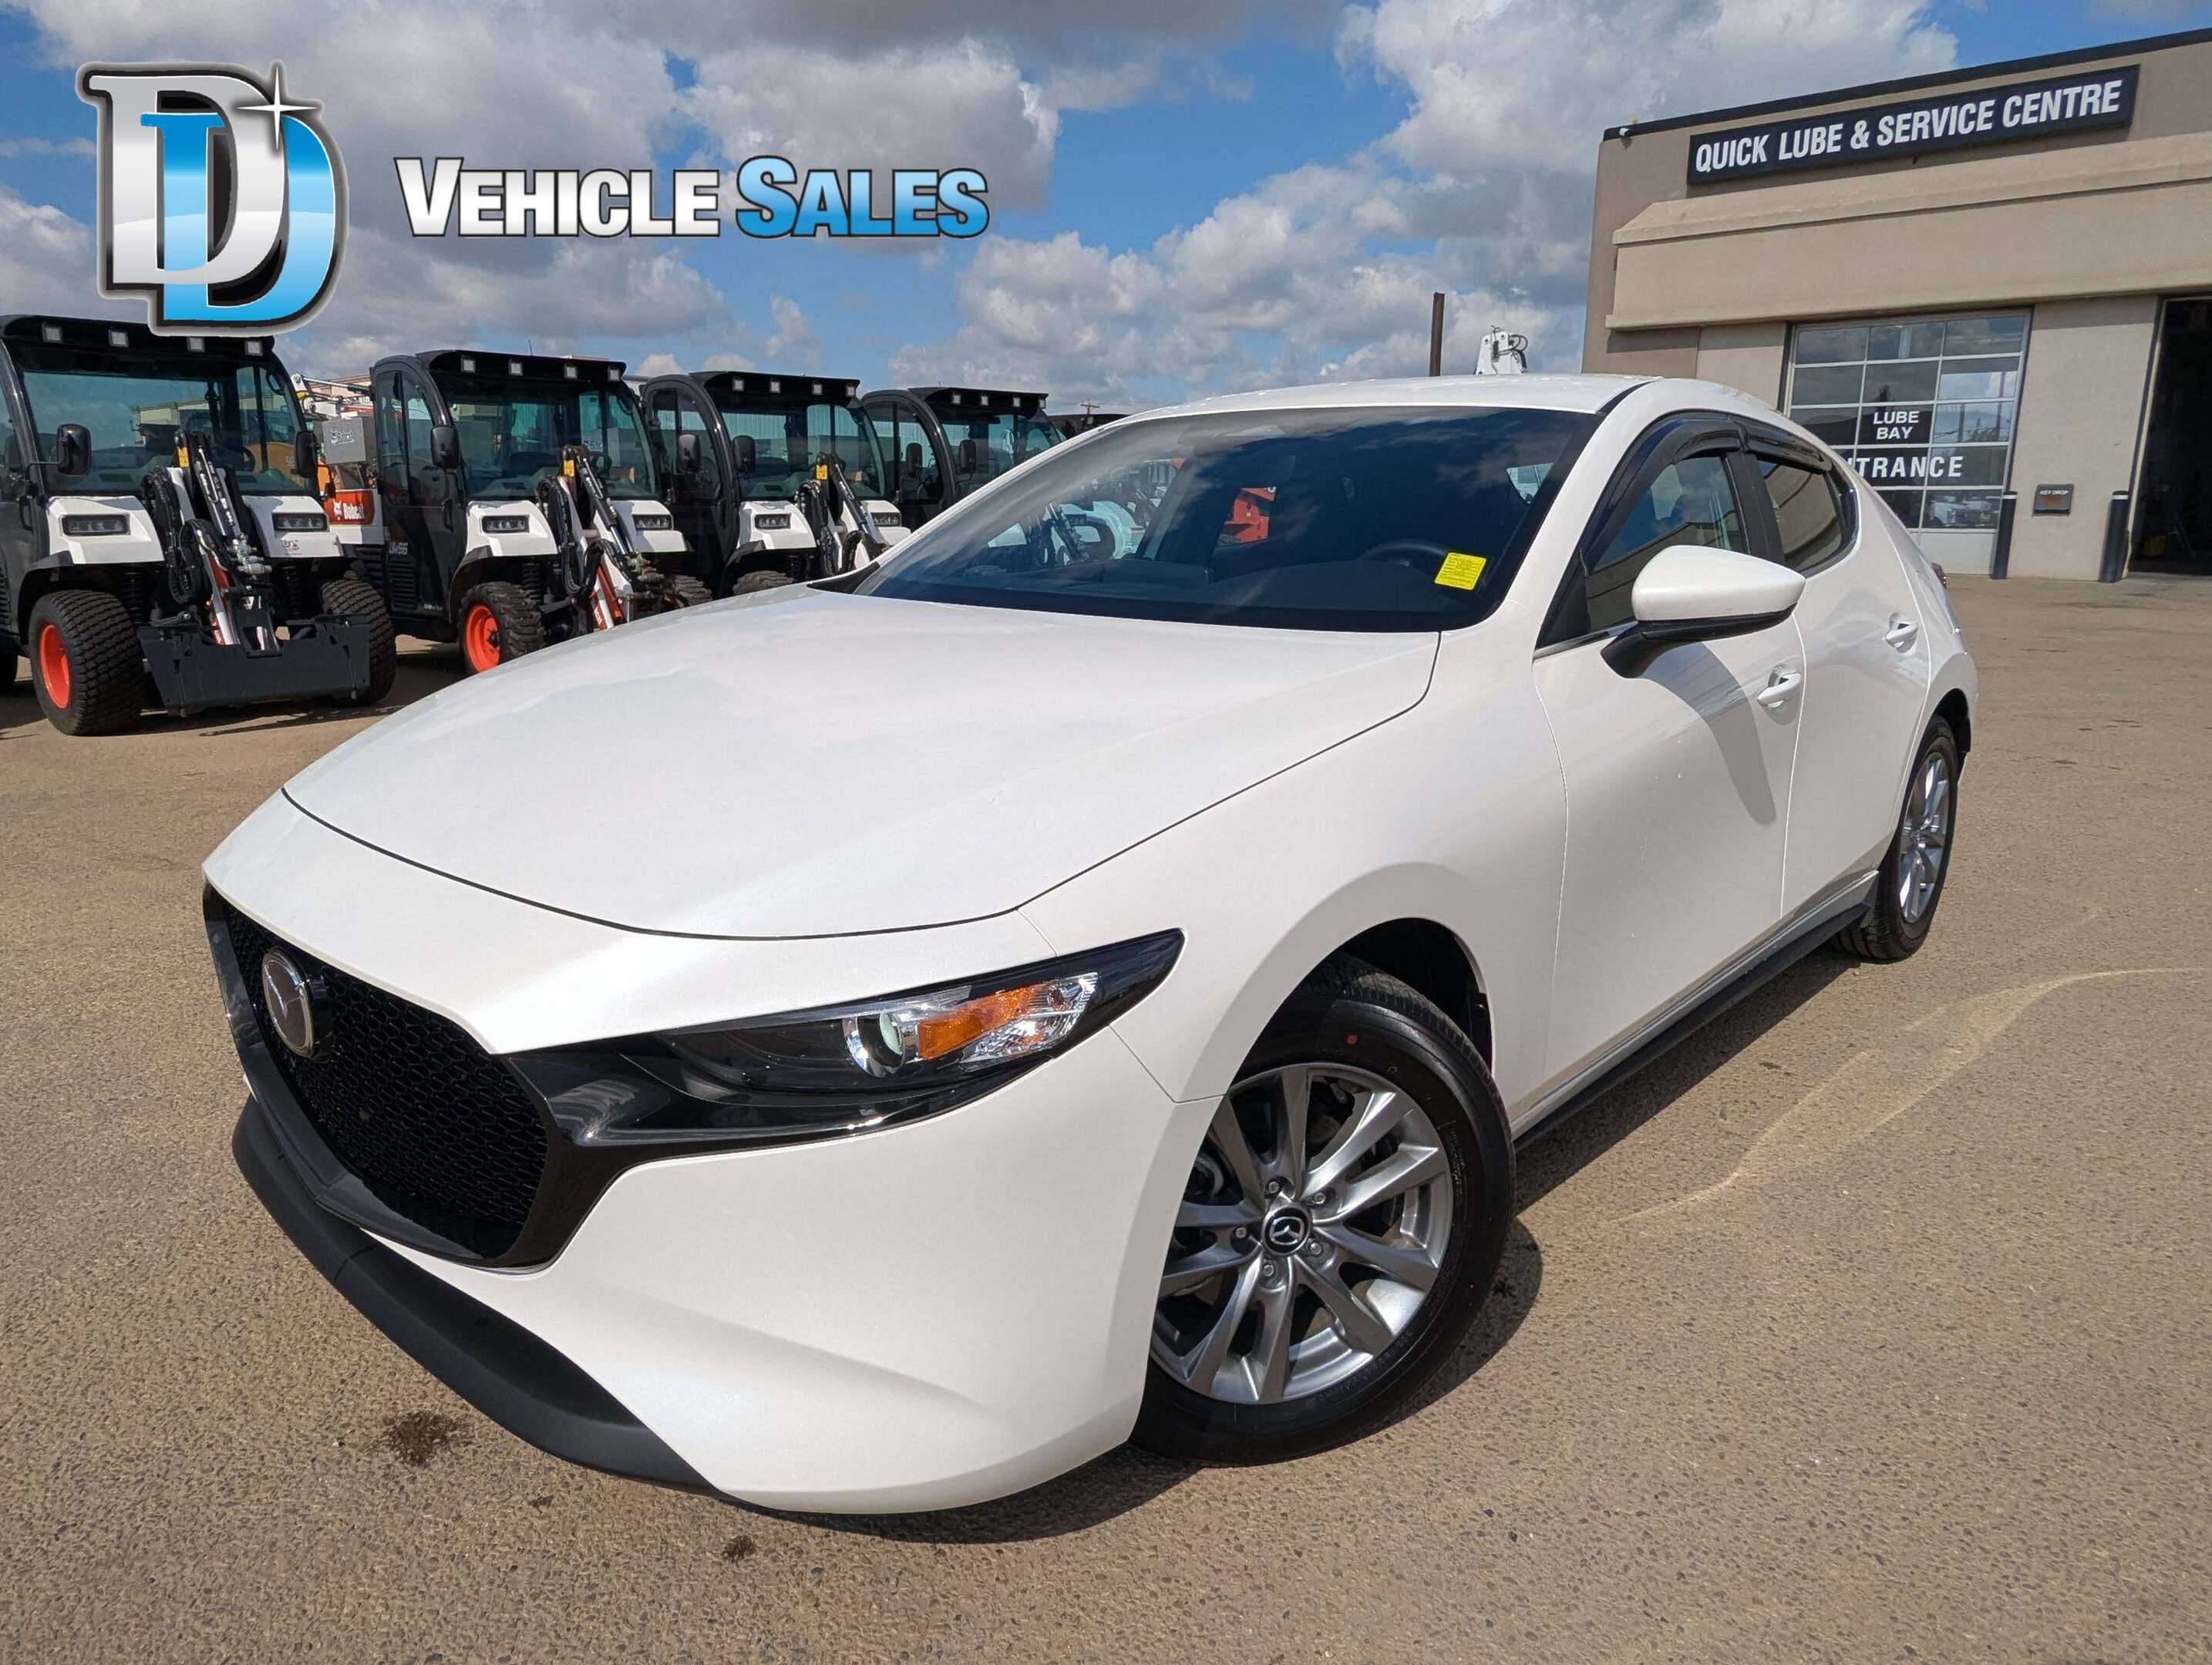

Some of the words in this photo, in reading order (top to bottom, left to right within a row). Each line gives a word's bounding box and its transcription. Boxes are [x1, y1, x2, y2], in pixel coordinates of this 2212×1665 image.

[1695, 133, 1770, 173] QUICK
[1778, 123, 1844, 160] LUBE
[1850, 119, 1870, 150] &
[1877, 99, 1995, 146] SERVICE
[2002, 80, 2123, 127] CENTRE
[1873, 411, 1920, 425] LUBE
[1876, 426, 1913, 440] BAY
[1847, 456, 1964, 478] TRANCE
